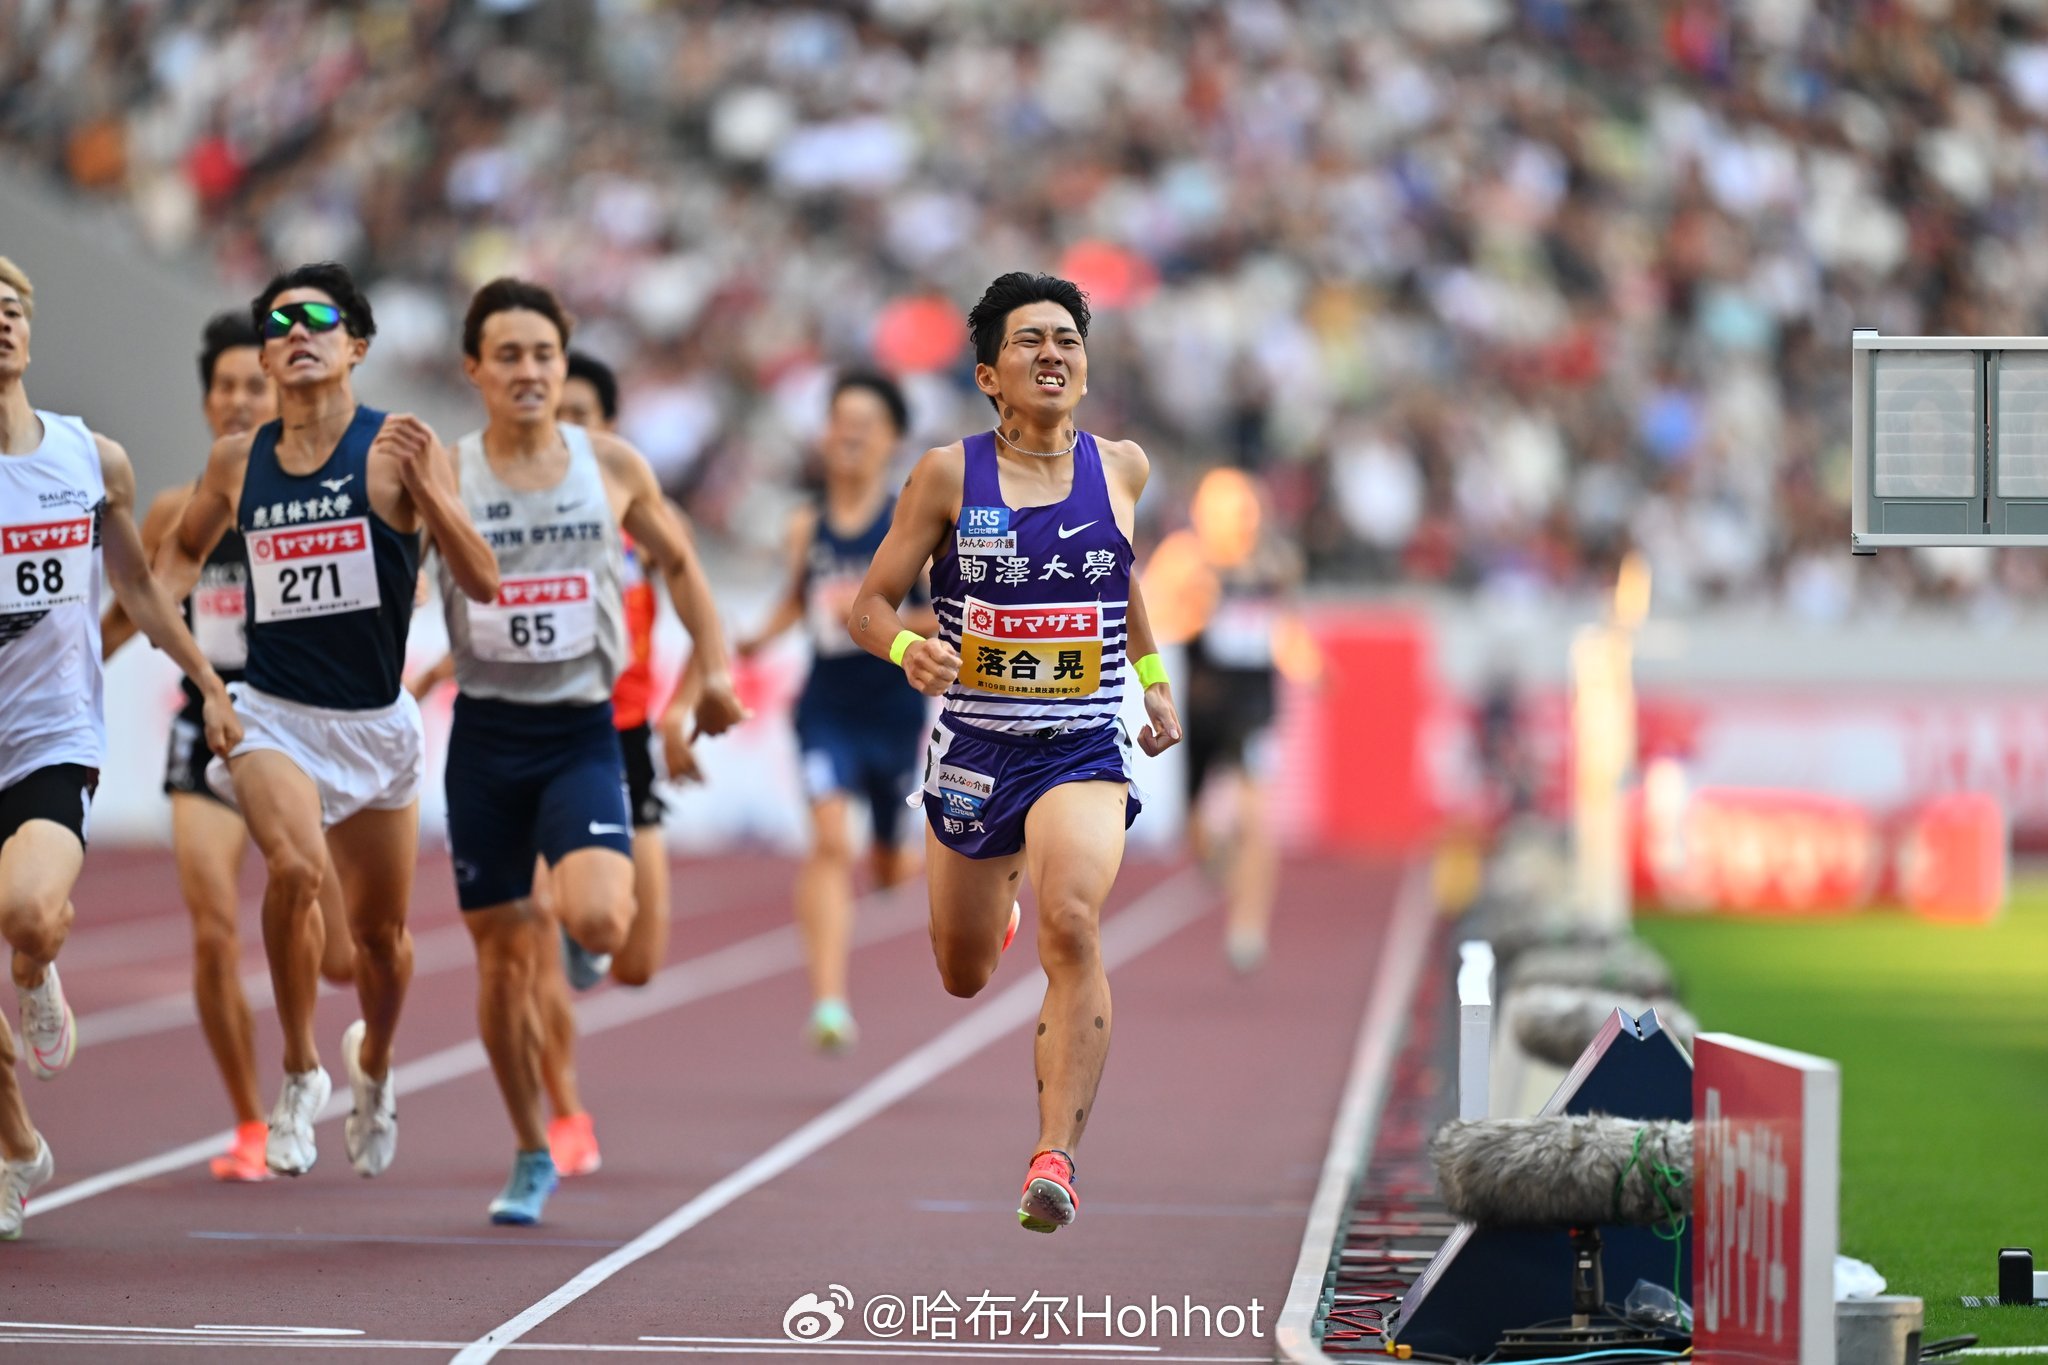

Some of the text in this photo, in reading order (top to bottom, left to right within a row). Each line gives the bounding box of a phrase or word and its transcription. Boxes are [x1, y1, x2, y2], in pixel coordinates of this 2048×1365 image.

[968, 509, 1000, 526] HRS
[7, 523, 88, 549] ヤマザキ
[276, 529, 360, 556] ヤマザキ
[531, 522, 601, 543] STATE
[959, 538, 1015, 549] みんなの介護
[16, 558, 64, 596] 68
[958, 549, 1116, 588] 駒澤大學
[279, 563, 341, 604] 271
[502, 580, 581, 603] ヤマザキ
[510, 614, 555, 647] 65
[1001, 613, 1092, 633] ヤマザキ
[975, 645, 1084, 680] 落合 晃
[939, 771, 991, 794] みんなの介護
[946, 793, 973, 810] HRS
[943, 815, 985, 834] 駒大
